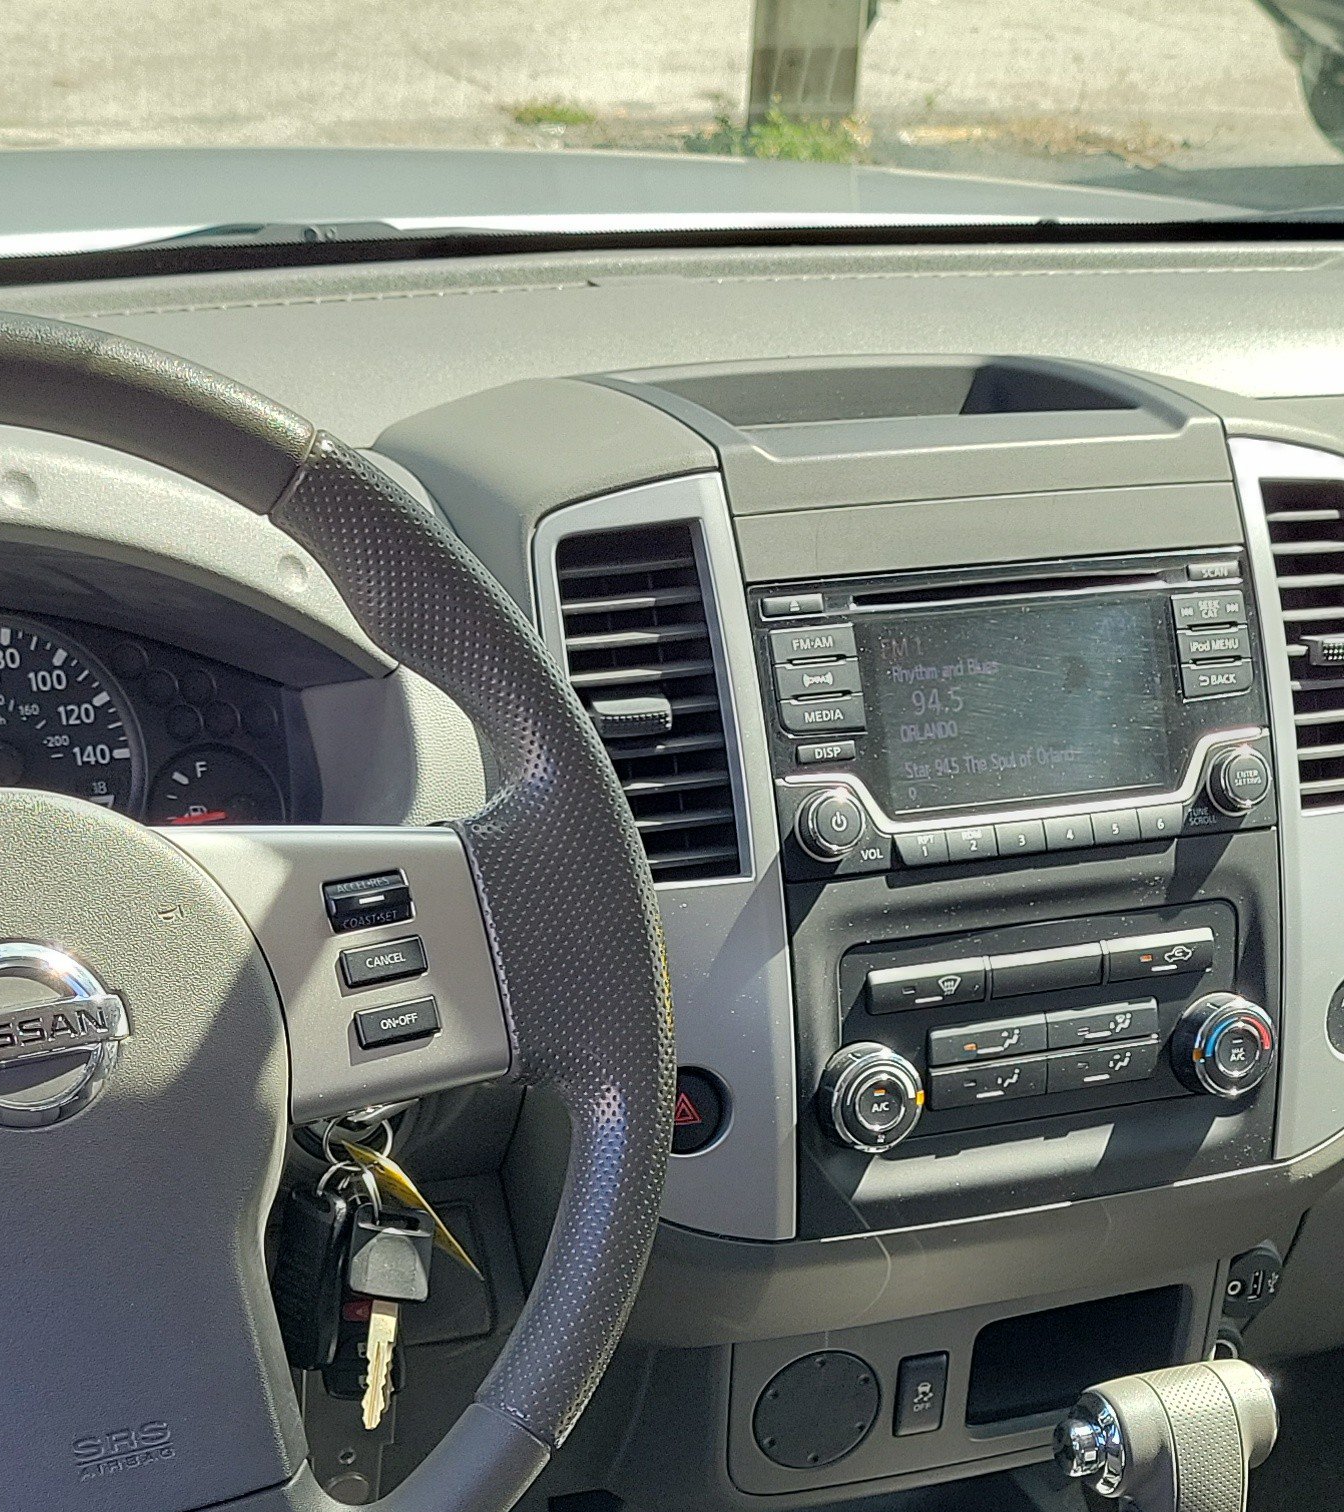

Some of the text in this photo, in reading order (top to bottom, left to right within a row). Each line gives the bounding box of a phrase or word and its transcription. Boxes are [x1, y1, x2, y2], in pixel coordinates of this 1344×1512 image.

[1202, 567, 1228, 578] SCAN
[1212, 638, 1239, 651] MENU
[942, 660, 964, 678] and
[28, 670, 67, 692] 100
[1211, 674, 1237, 686] BACK
[912, 687, 964, 716] 94.5
[57, 704, 95, 726] 120
[804, 709, 844, 724] MEDIA
[900, 721, 958, 743] ORLANDO
[46, 735, 70, 748] 200
[73, 744, 111, 766] 140
[814, 747, 842, 760] DISP
[963, 755, 987, 774] The
[1019, 748, 1032, 768] of
[195, 761, 209, 779] F
[1112, 823, 1119, 835] 5
[1156, 818, 1165, 830] 6
[1066, 828, 1074, 840] 4
[970, 840, 978, 851] 2
[1018, 835, 1026, 847] 3
[860, 848, 884, 861] VOL
[922, 846, 929, 857] 1
[365, 949, 408, 969] CANCEL
[1230, 1053, 1246, 1062] A/C
[871, 1102, 890, 1113] A/C
[913, 1402, 932, 1412] OFF
[72, 1421, 172, 1463] SRS
[78, 1447, 177, 1482] AIRBAG
